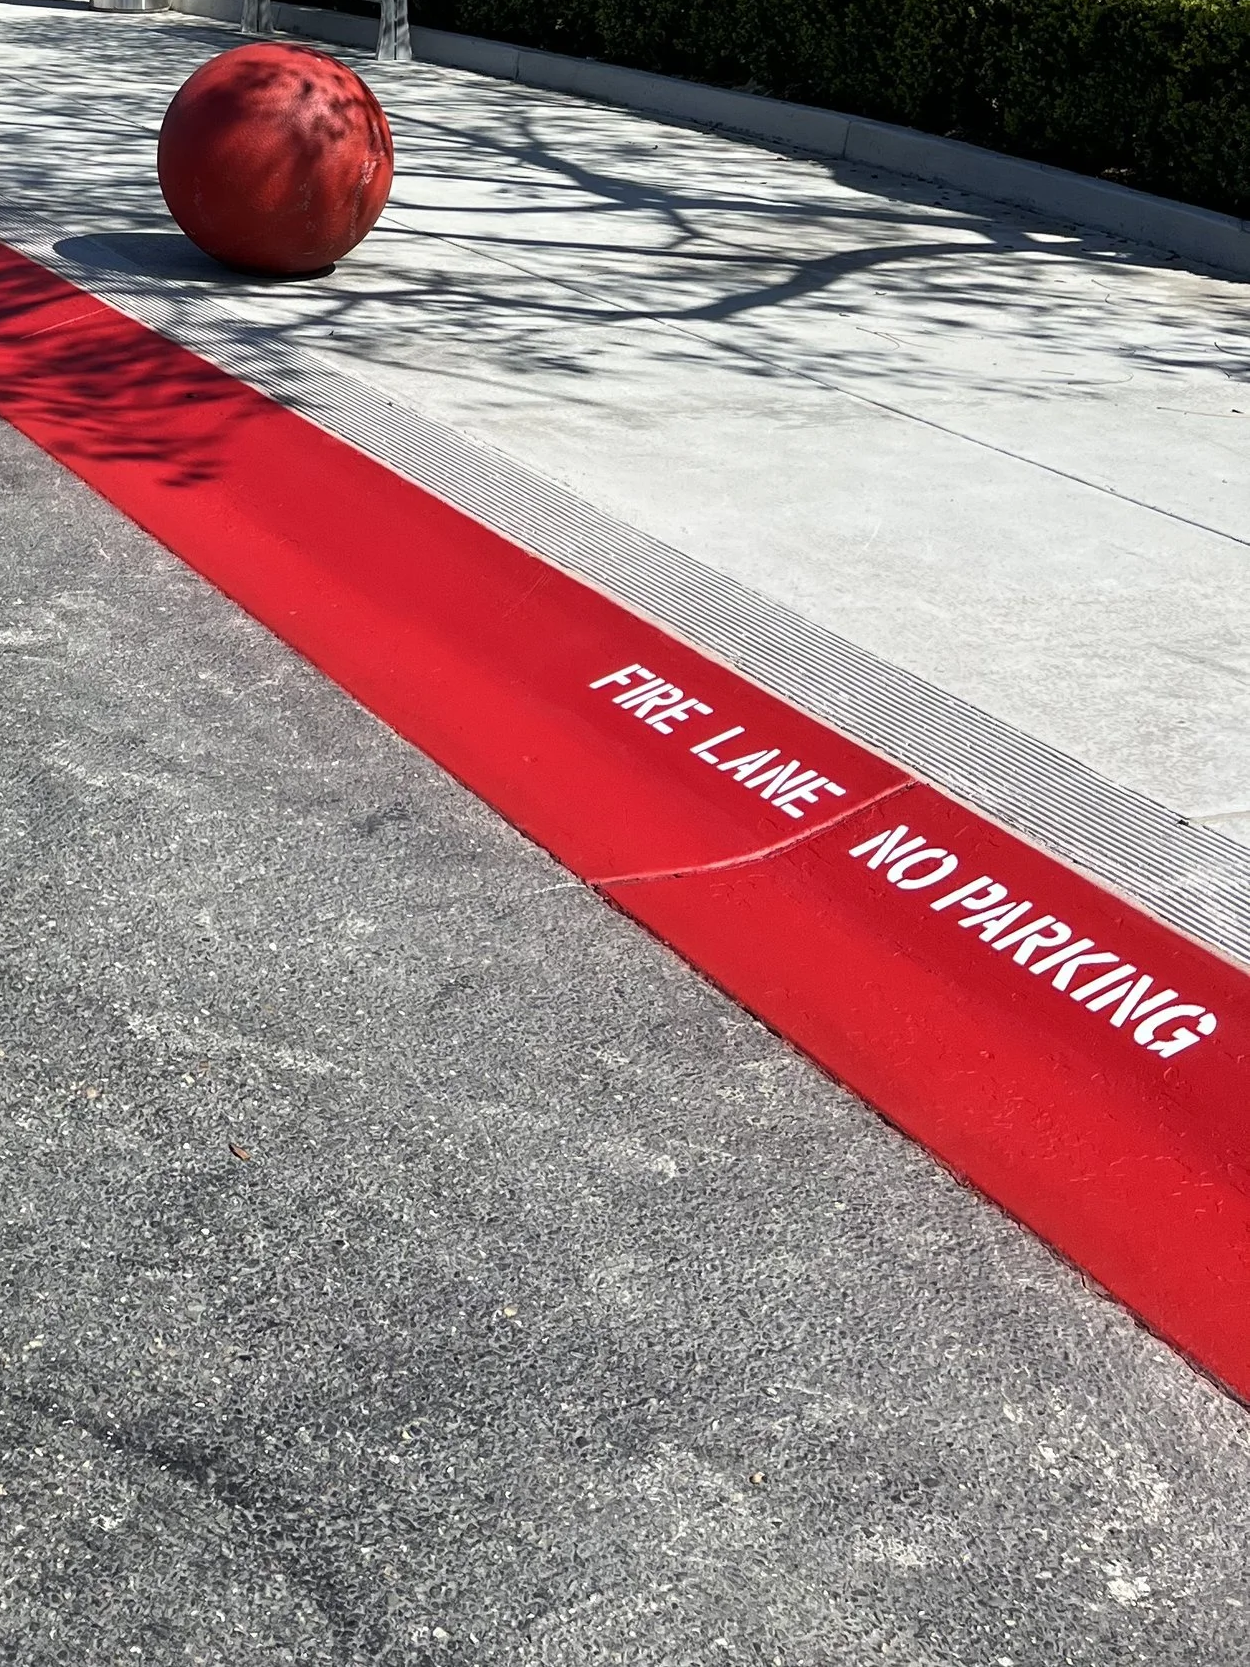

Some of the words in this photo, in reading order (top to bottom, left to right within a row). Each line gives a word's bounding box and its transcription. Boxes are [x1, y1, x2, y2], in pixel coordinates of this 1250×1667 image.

[590, 664, 713, 734] FIRE
[690, 726, 846, 818] LANE
[850, 824, 958, 890] NO
[930, 875, 1217, 1059] PARKING
